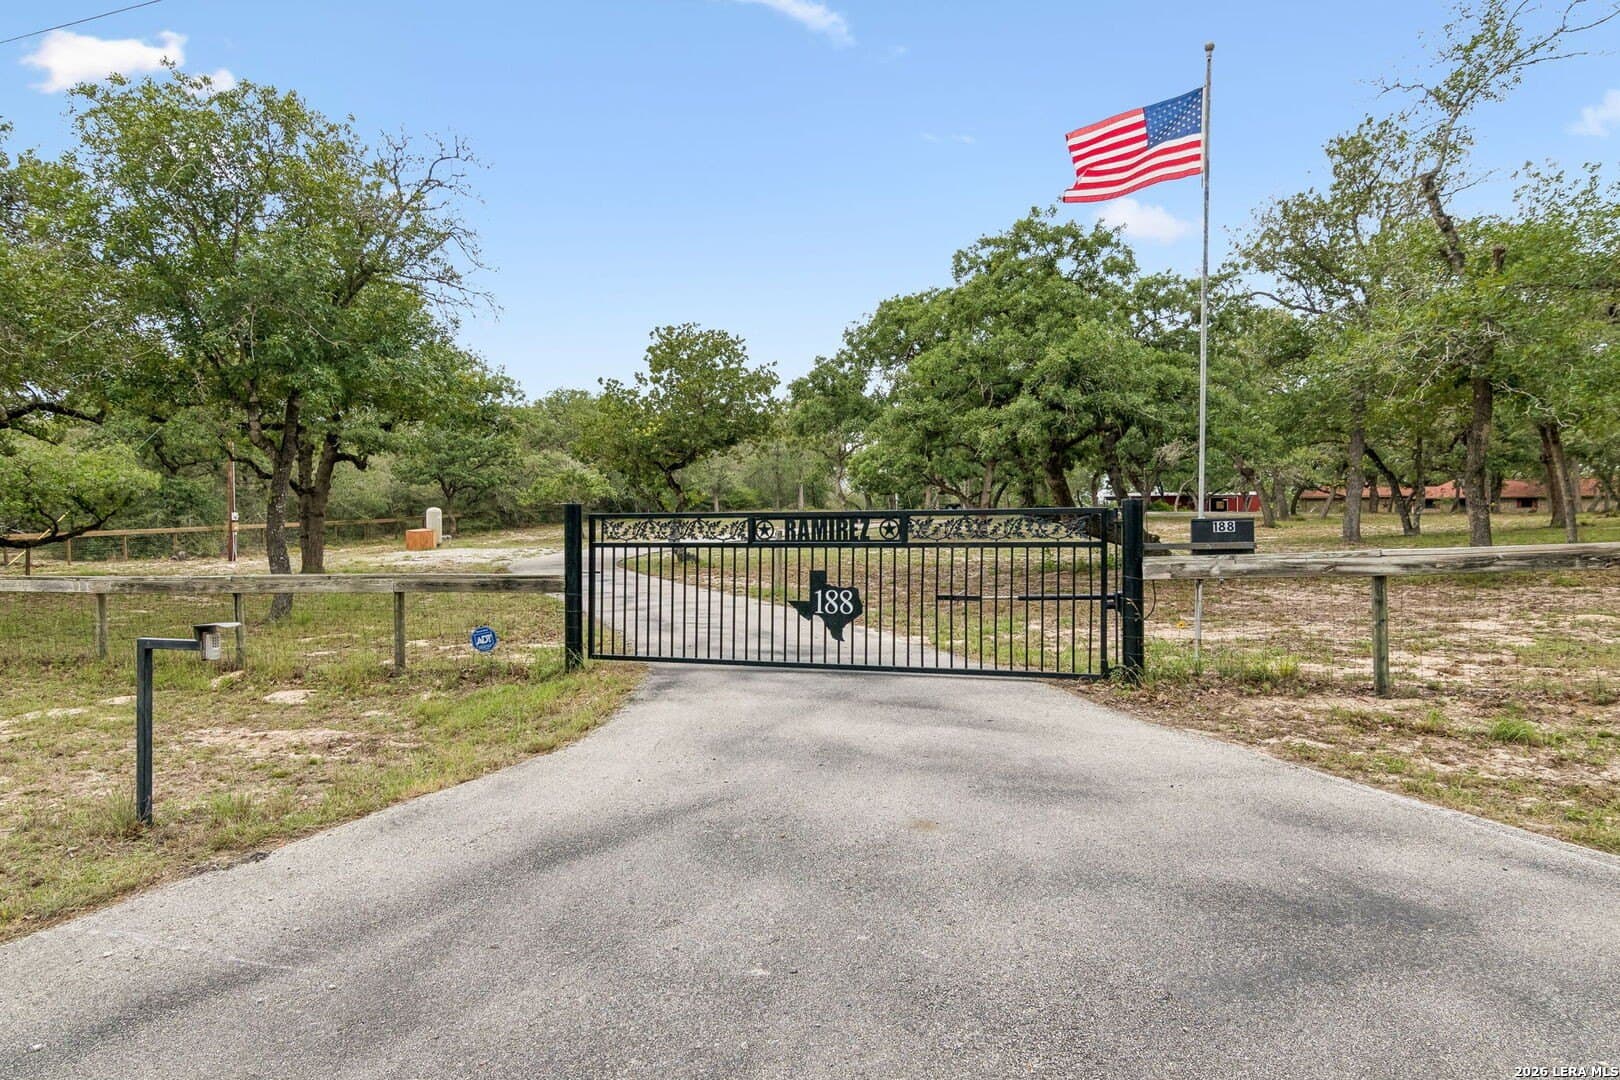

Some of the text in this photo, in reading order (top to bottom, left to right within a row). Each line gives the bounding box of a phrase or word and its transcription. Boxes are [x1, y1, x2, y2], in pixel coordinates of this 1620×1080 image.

[785, 517, 871, 542] RAMIREZ
[1213, 520, 1236, 533] 188
[814, 589, 854, 615] 188
[476, 633, 494, 645] ADT
